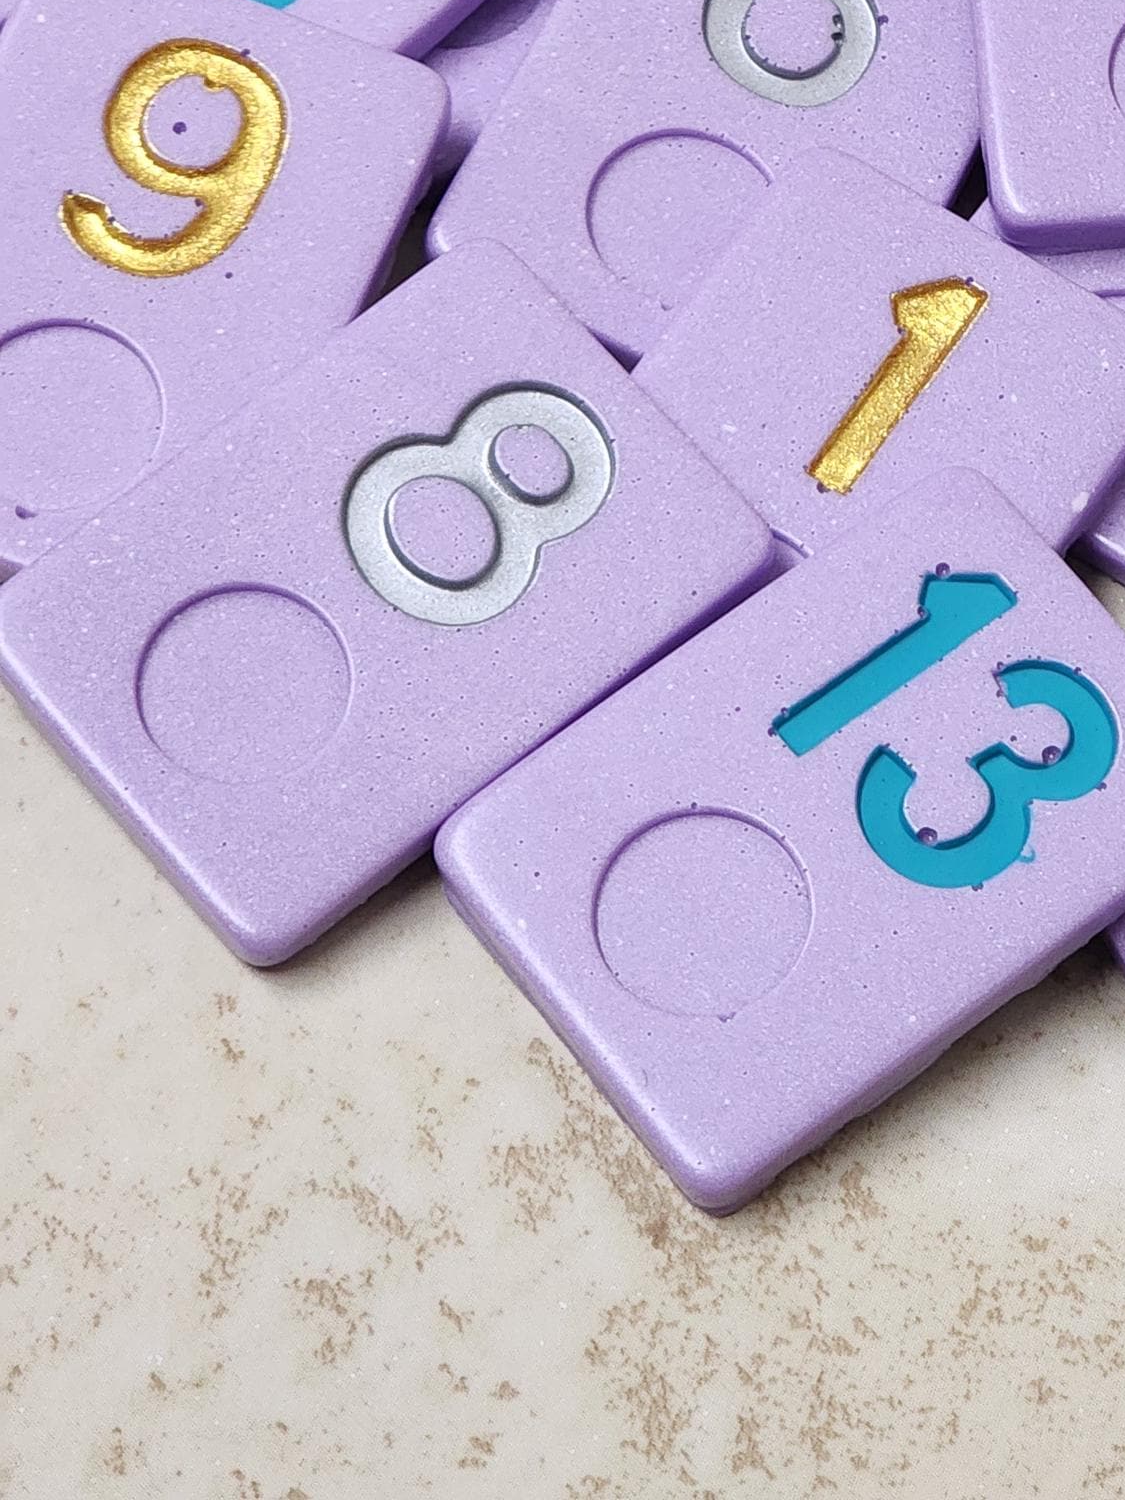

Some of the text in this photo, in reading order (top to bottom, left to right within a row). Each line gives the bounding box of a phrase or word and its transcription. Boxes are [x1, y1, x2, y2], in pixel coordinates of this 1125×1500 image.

[60, 37, 289, 278] 9
[342, 380, 616, 628] 8
[805, 276, 989, 495] 1
[769, 564, 1122, 891] 13
